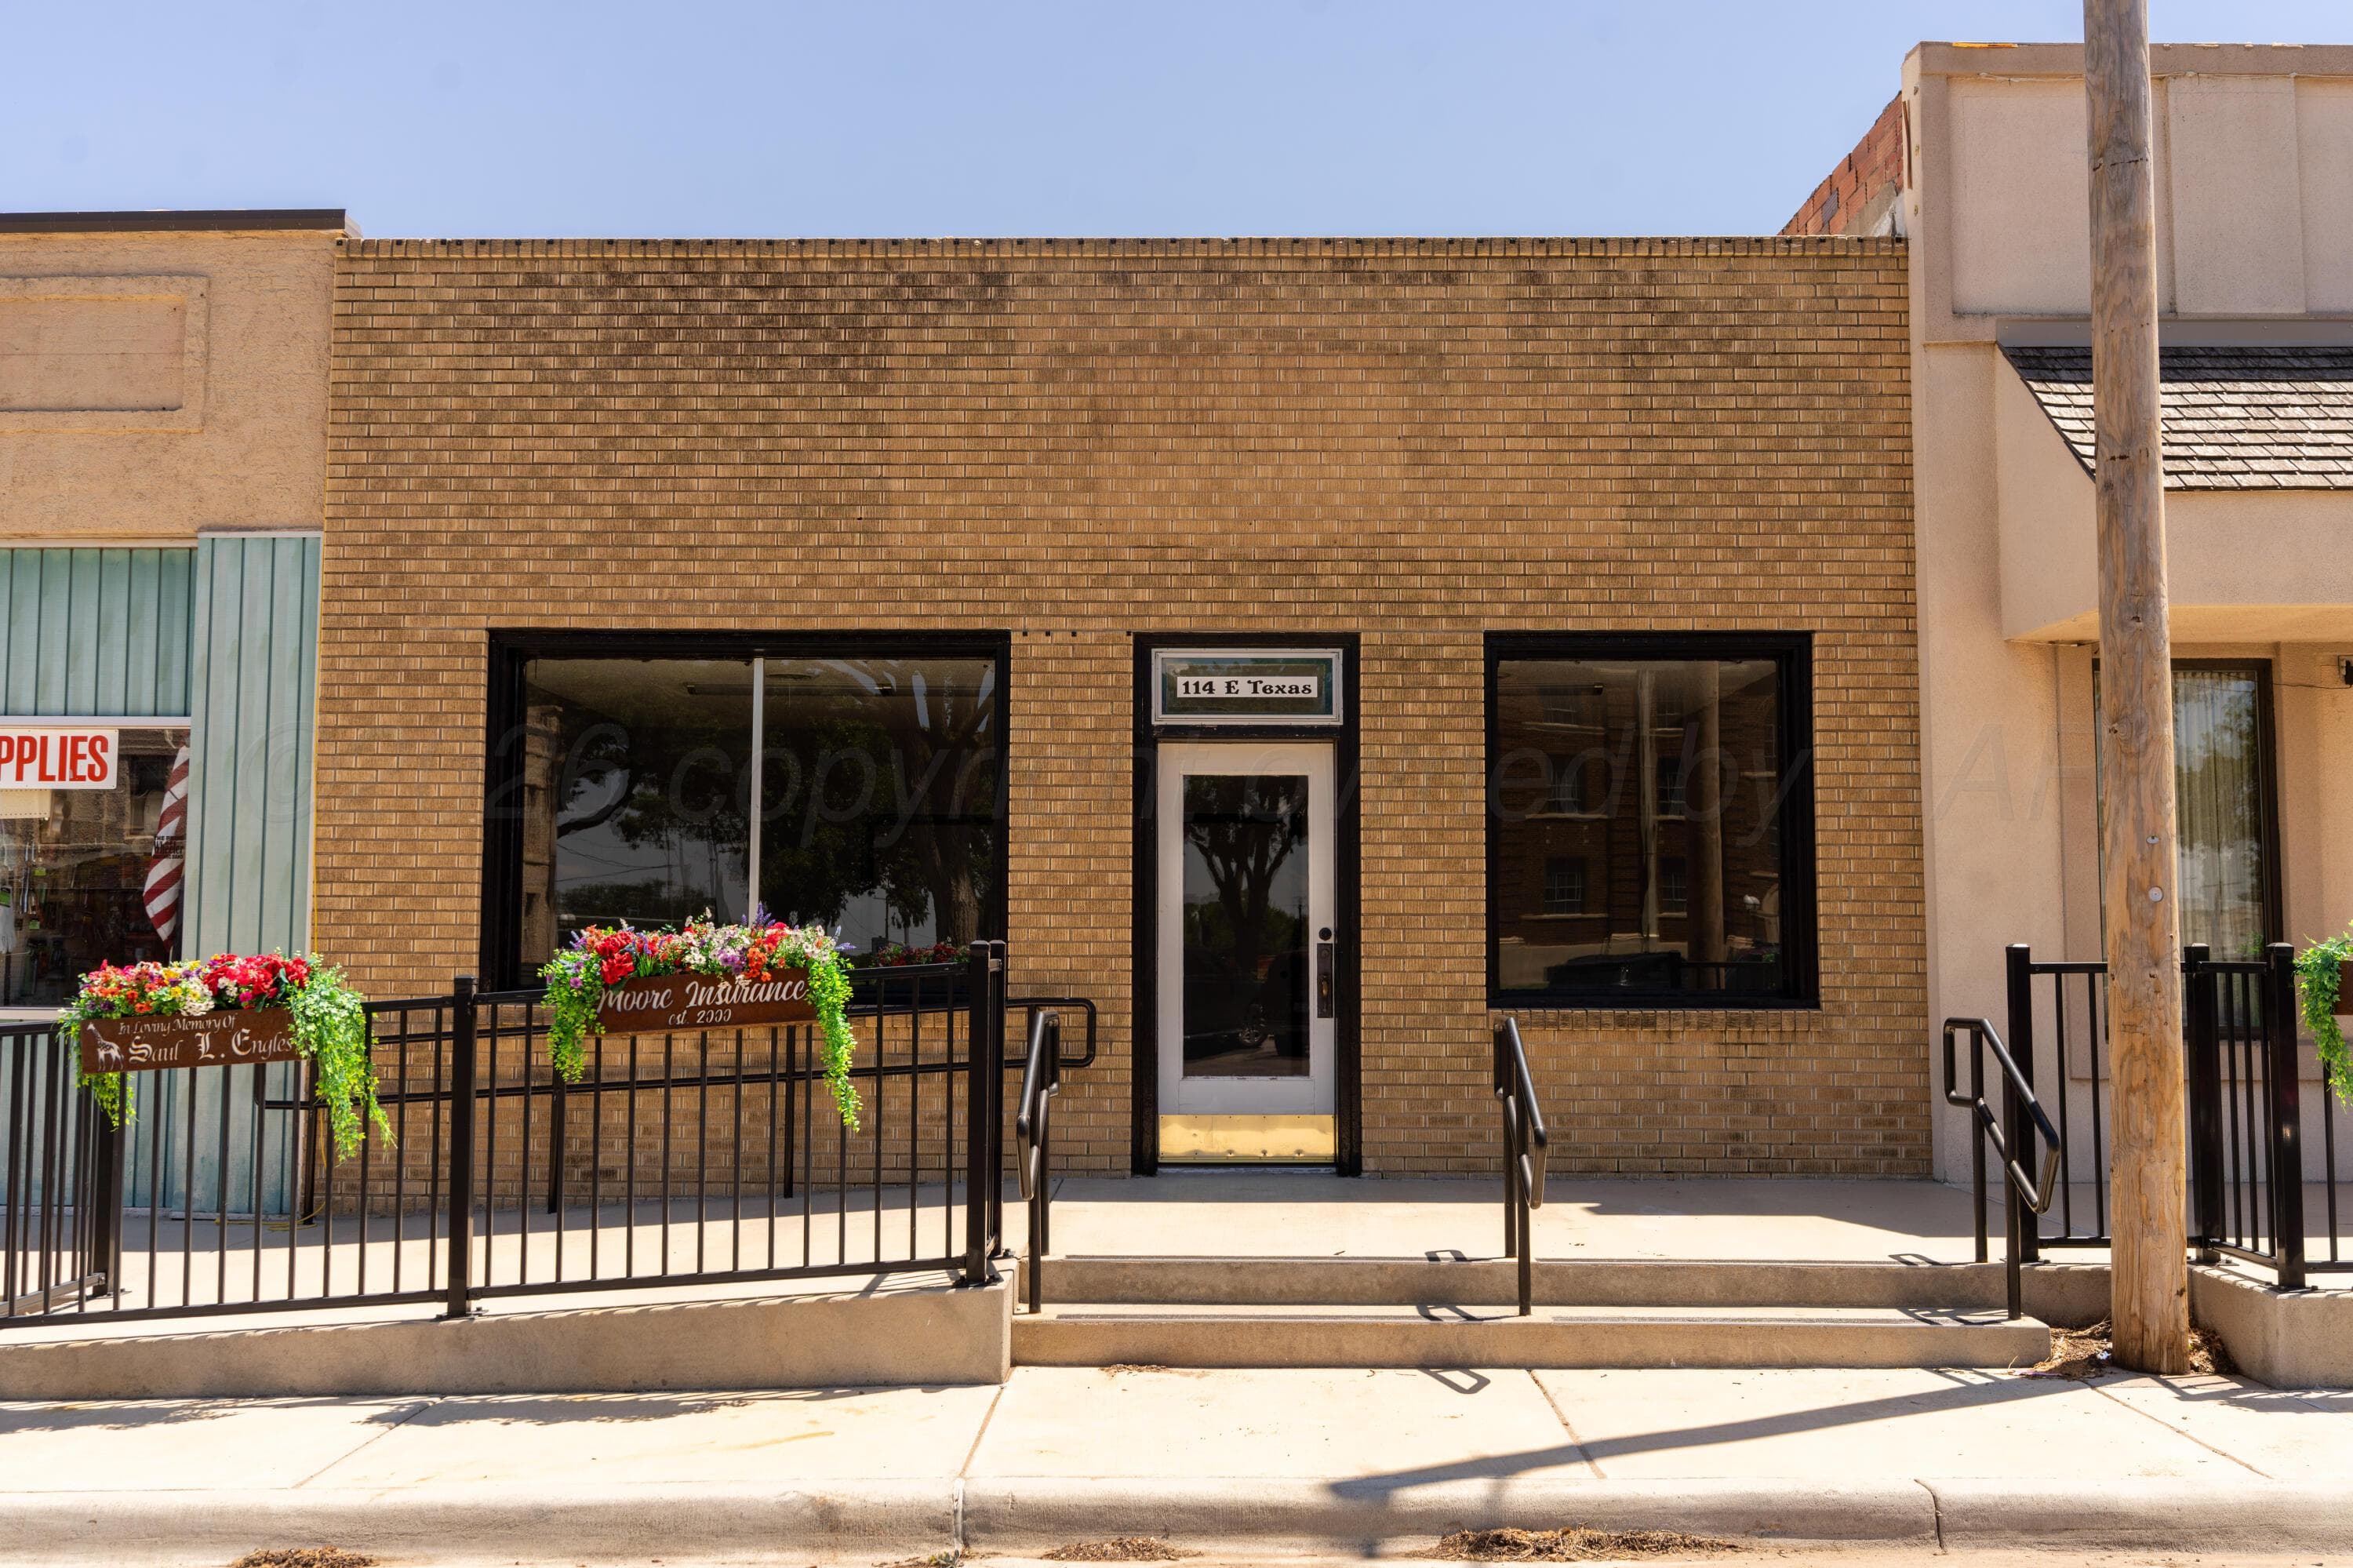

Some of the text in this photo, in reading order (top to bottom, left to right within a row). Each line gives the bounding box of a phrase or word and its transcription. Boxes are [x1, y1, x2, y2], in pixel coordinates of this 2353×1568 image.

[1182, 679, 1312, 695] 114 E Texas
[596, 979, 809, 1014] Moore Insurance
[696, 1009, 732, 1024] 2000
[118, 1021, 131, 1035] In
[133, 1020, 171, 1037] Loving
[172, 1017, 221, 1034] Memory
[129, 1035, 184, 1064] Saul
[195, 1031, 226, 1060] L.
